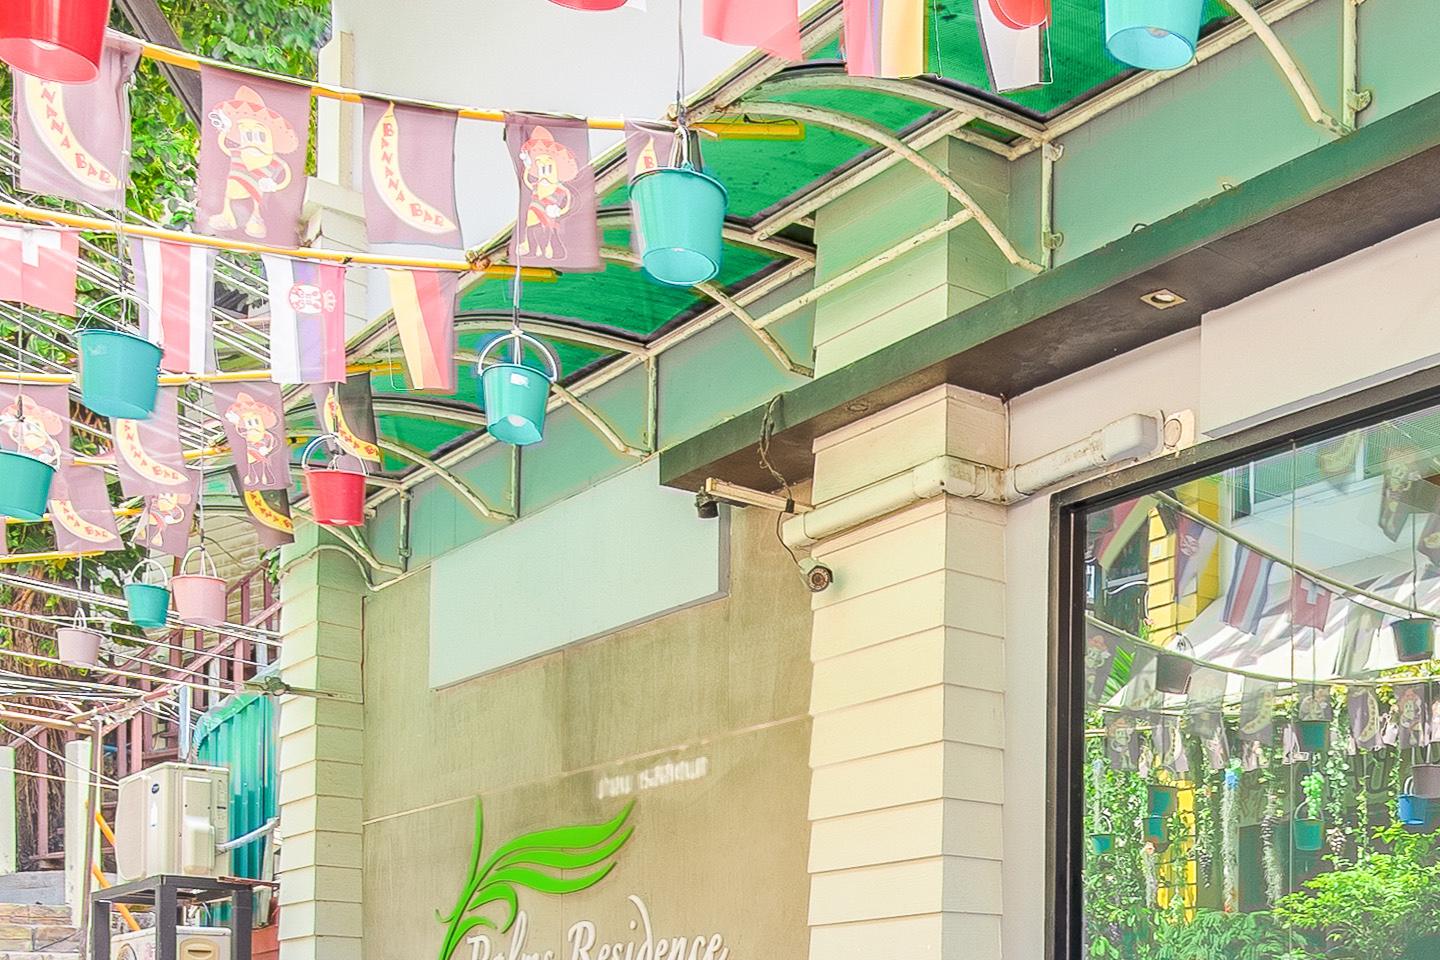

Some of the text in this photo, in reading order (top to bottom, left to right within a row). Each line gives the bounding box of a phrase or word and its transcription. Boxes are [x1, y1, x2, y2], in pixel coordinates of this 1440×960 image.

[41, 80, 111, 184] NANA BAR
[380, 121, 444, 227] BANANA BAR
[123, 419, 148, 467] ANANA
